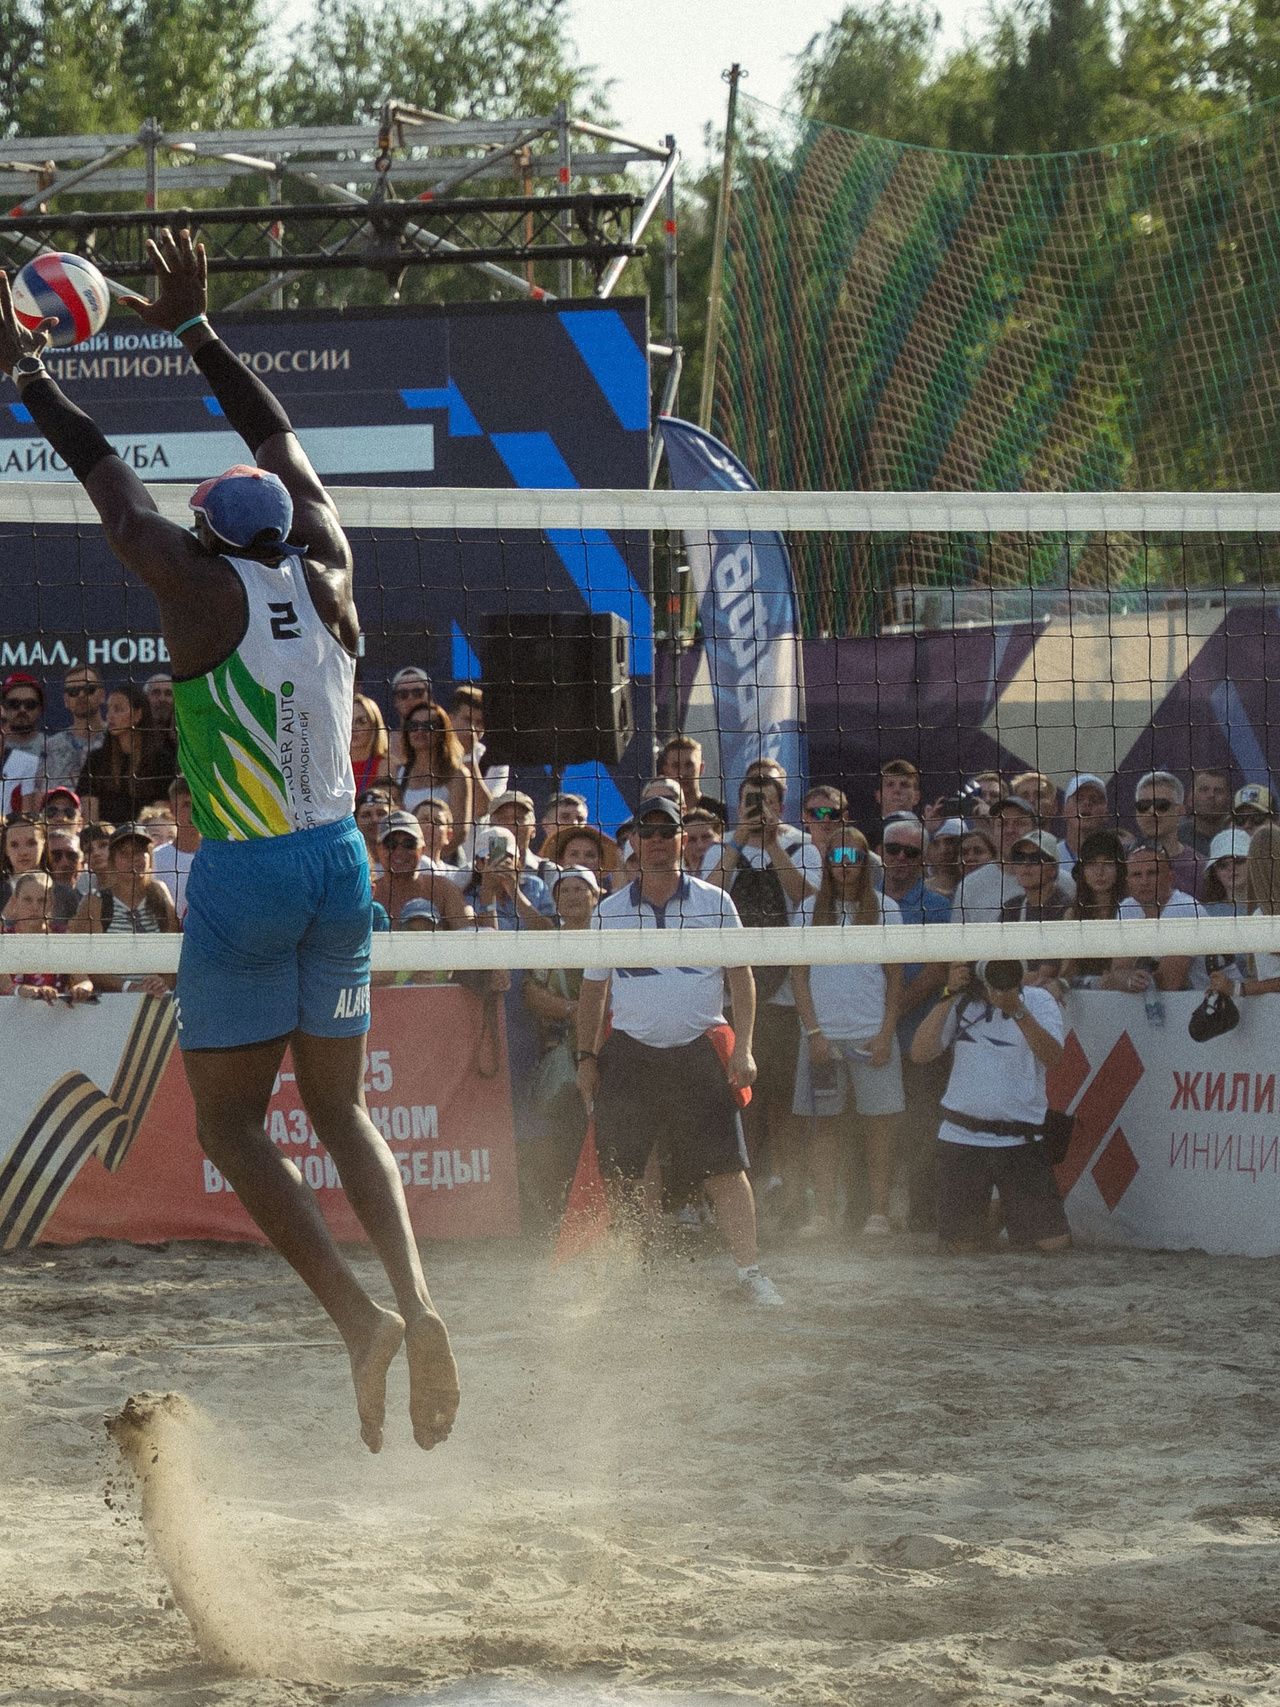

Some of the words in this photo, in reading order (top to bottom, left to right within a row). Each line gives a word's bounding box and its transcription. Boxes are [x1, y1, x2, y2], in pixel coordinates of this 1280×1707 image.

[46, 355, 201, 380] ЧЕМПИОНА
[267, 601, 302, 640] 2
[280, 680, 295, 734] AUTO
[1171, 1070, 1280, 1114] ЖИЛИ
[393, 1149, 491, 1191] БЕДЫ!
